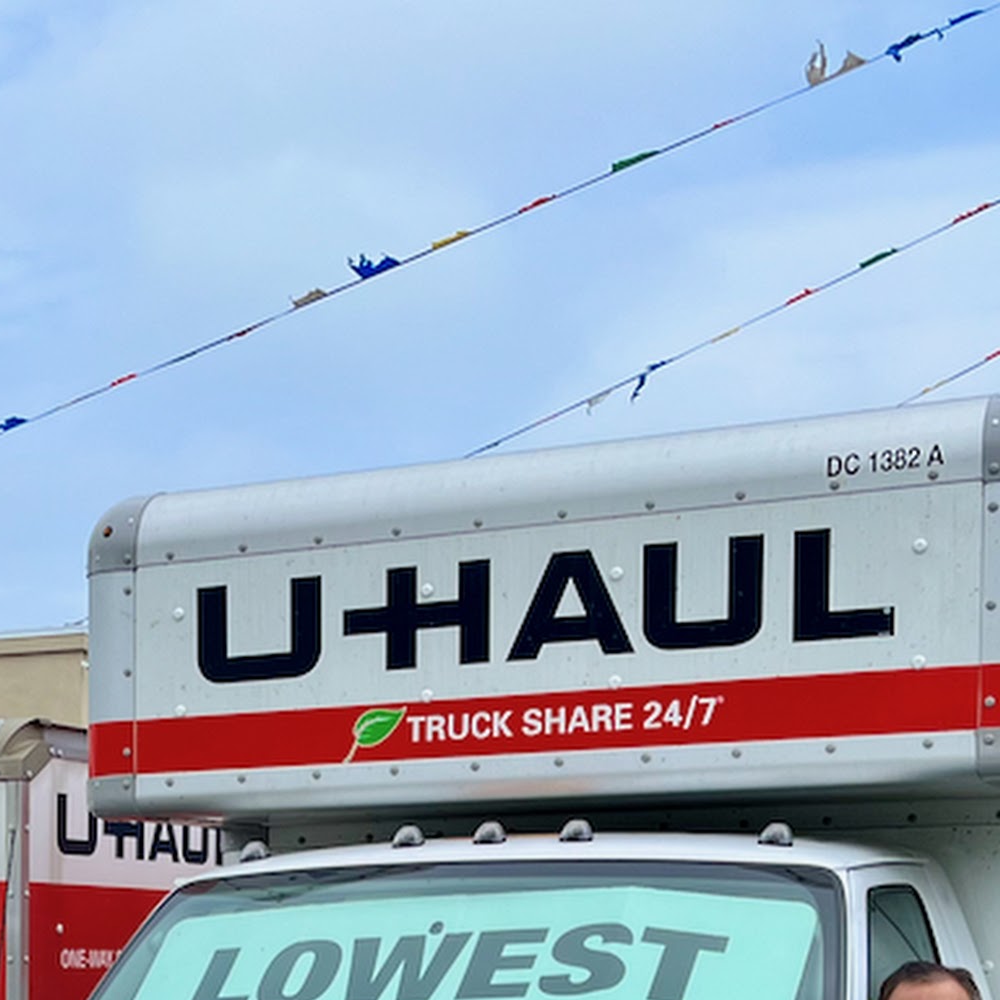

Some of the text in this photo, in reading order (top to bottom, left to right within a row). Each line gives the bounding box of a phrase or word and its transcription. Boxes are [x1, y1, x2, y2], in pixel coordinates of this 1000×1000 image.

[827, 444, 944, 477] DC 1382 A
[197, 528, 895, 684] U-HAUL
[407, 695, 717, 742] TRUCK SHARE 24/7
